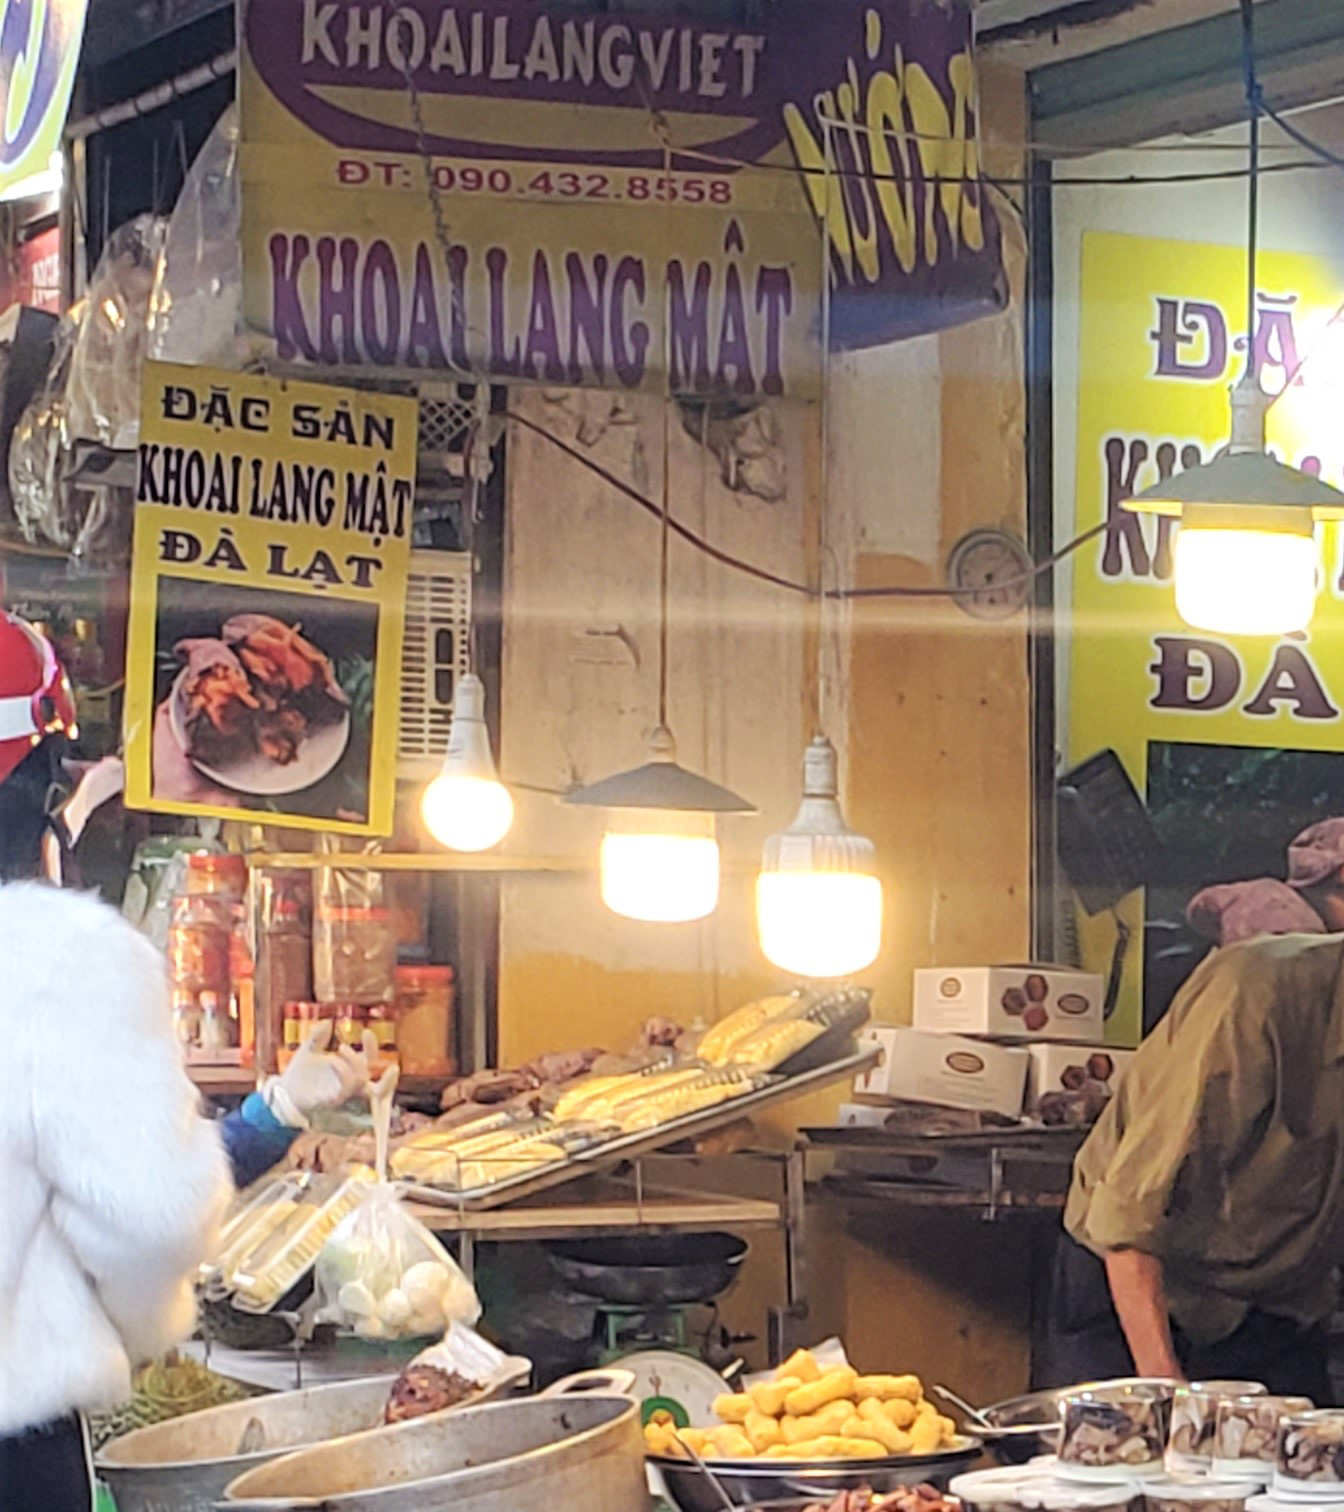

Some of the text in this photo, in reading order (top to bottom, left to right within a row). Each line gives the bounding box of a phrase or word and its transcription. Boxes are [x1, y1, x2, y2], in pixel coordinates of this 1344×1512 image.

[337, 160, 733, 204] ĐT: 090.432.8558
[269, 232, 469, 370] KHOAI
[485, 246, 649, 387] LANG
[160, 384, 395, 450] ĐẶC SẢN
[137, 442, 412, 548] KHOAI LANG MẬT
[159, 528, 384, 590] ĐÀ LẠT
